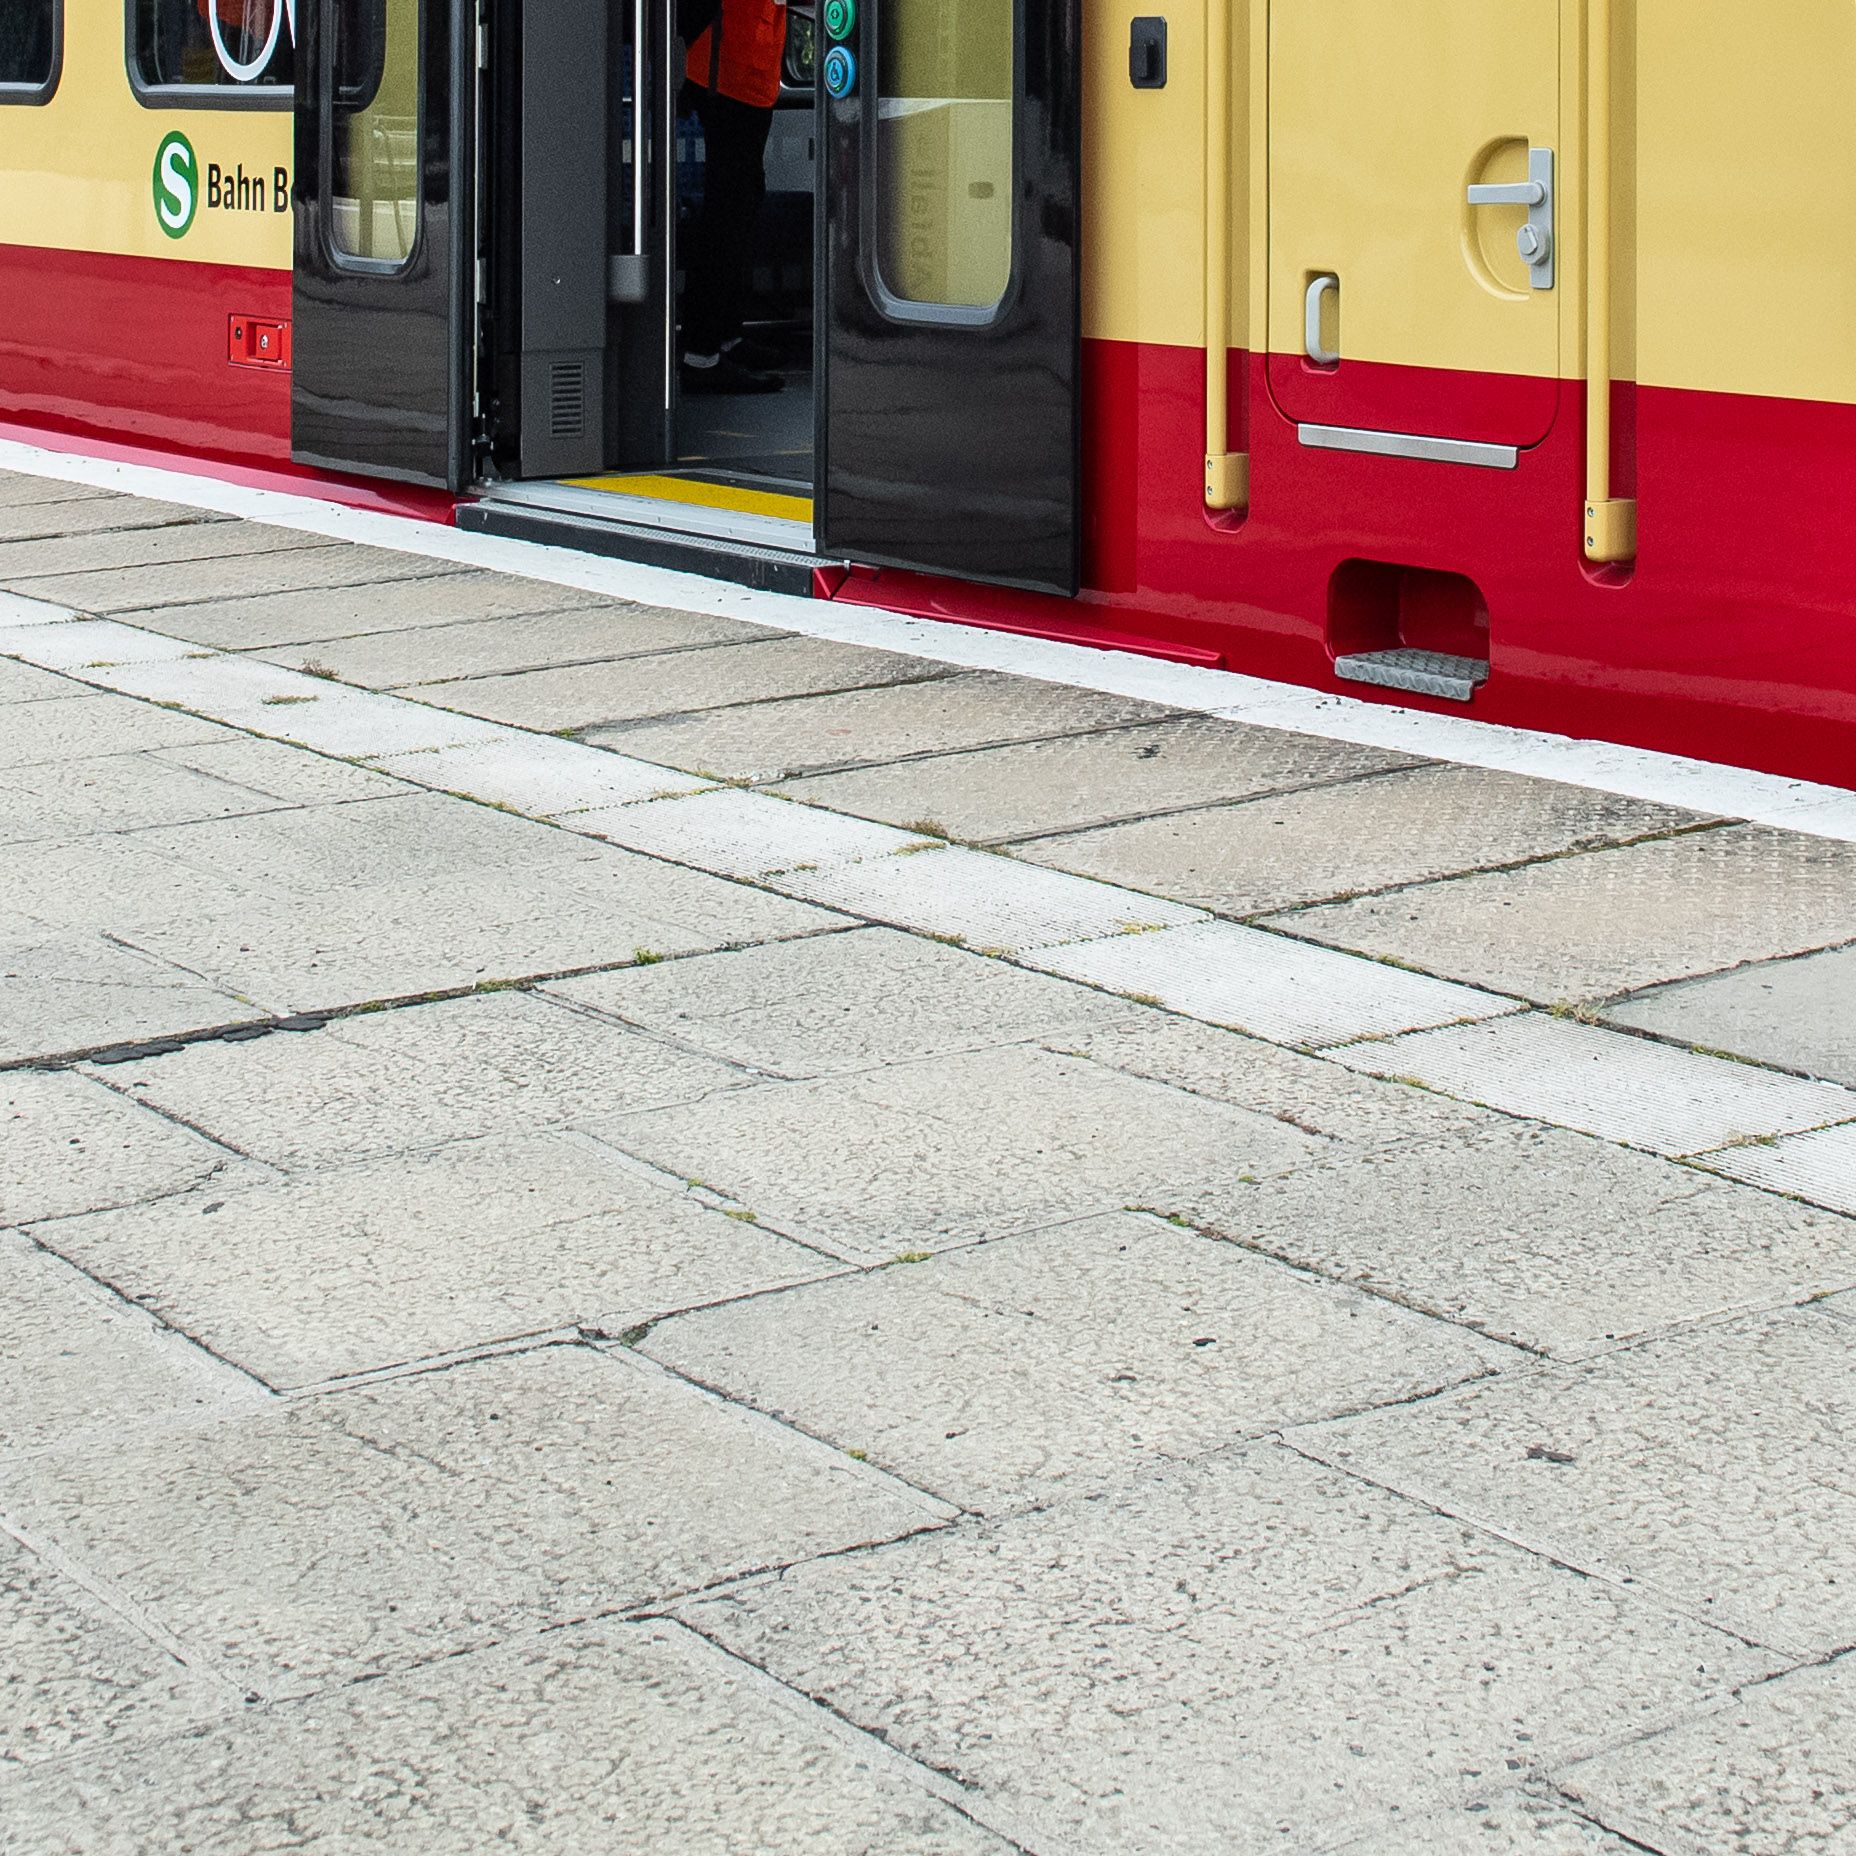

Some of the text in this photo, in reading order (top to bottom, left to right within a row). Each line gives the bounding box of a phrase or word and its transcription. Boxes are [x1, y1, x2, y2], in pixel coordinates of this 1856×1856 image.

[160, 141, 294, 229] S Bahn B
